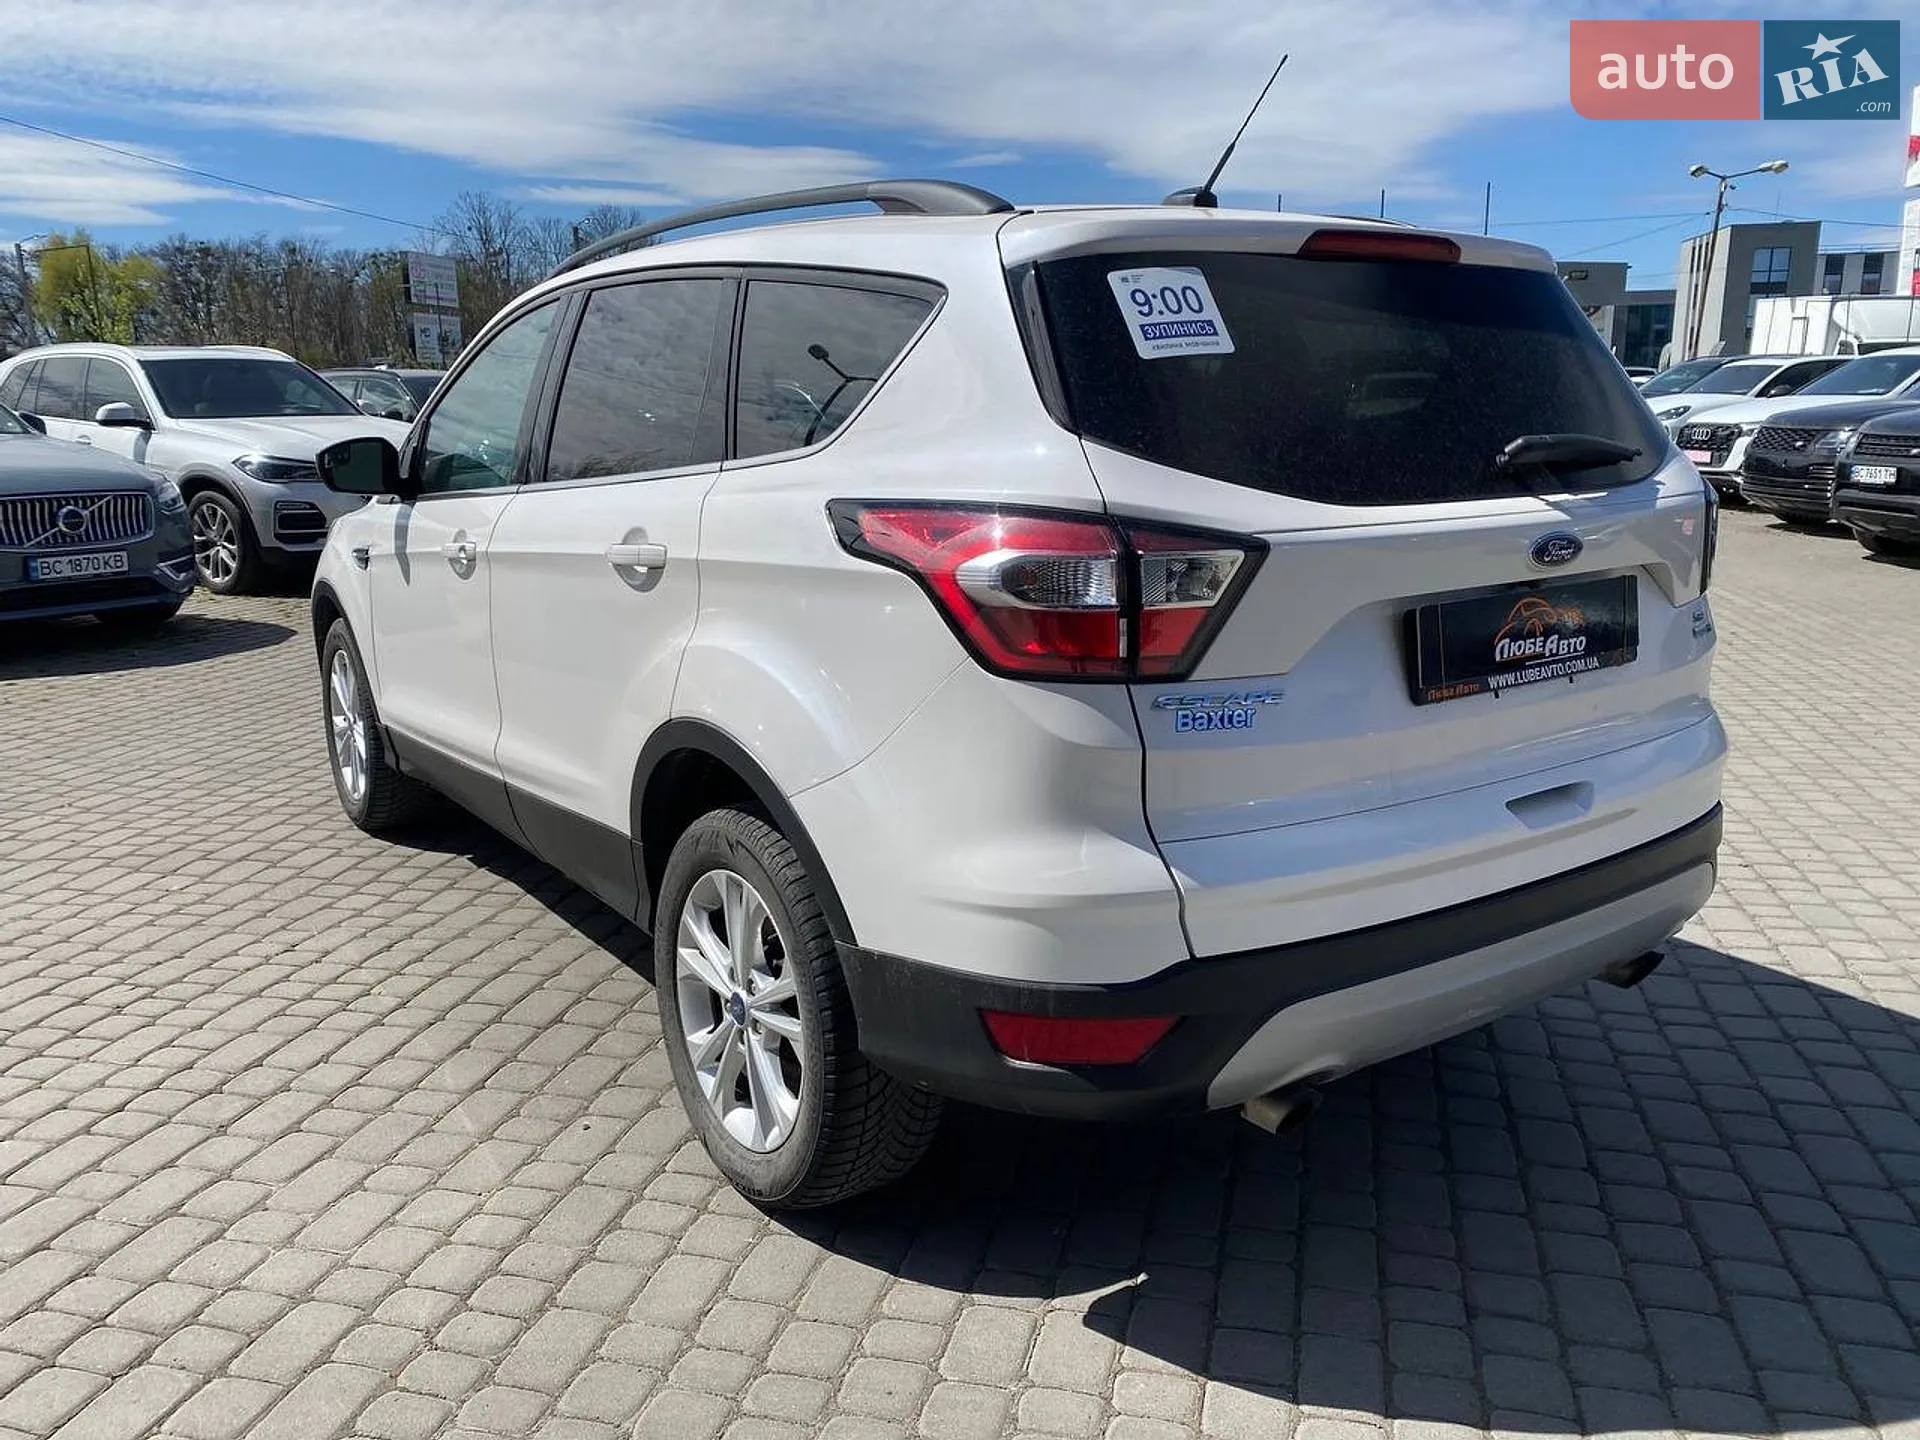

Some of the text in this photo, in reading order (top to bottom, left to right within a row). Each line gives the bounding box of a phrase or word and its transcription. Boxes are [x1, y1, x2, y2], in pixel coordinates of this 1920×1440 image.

[1129, 285, 1204, 317] 9:00
[1143, 321, 1215, 338] ЗУПИНИСЬ
[40, 560, 64, 576] BC
[66, 557, 101, 573] 1870
[103, 554, 124, 570] KB
[1487, 656, 1600, 690] WWW.LUBEAVTO.COM.UA
[1151, 690, 1284, 710] ESCAPE
[1175, 707, 1256, 733] Baxter
